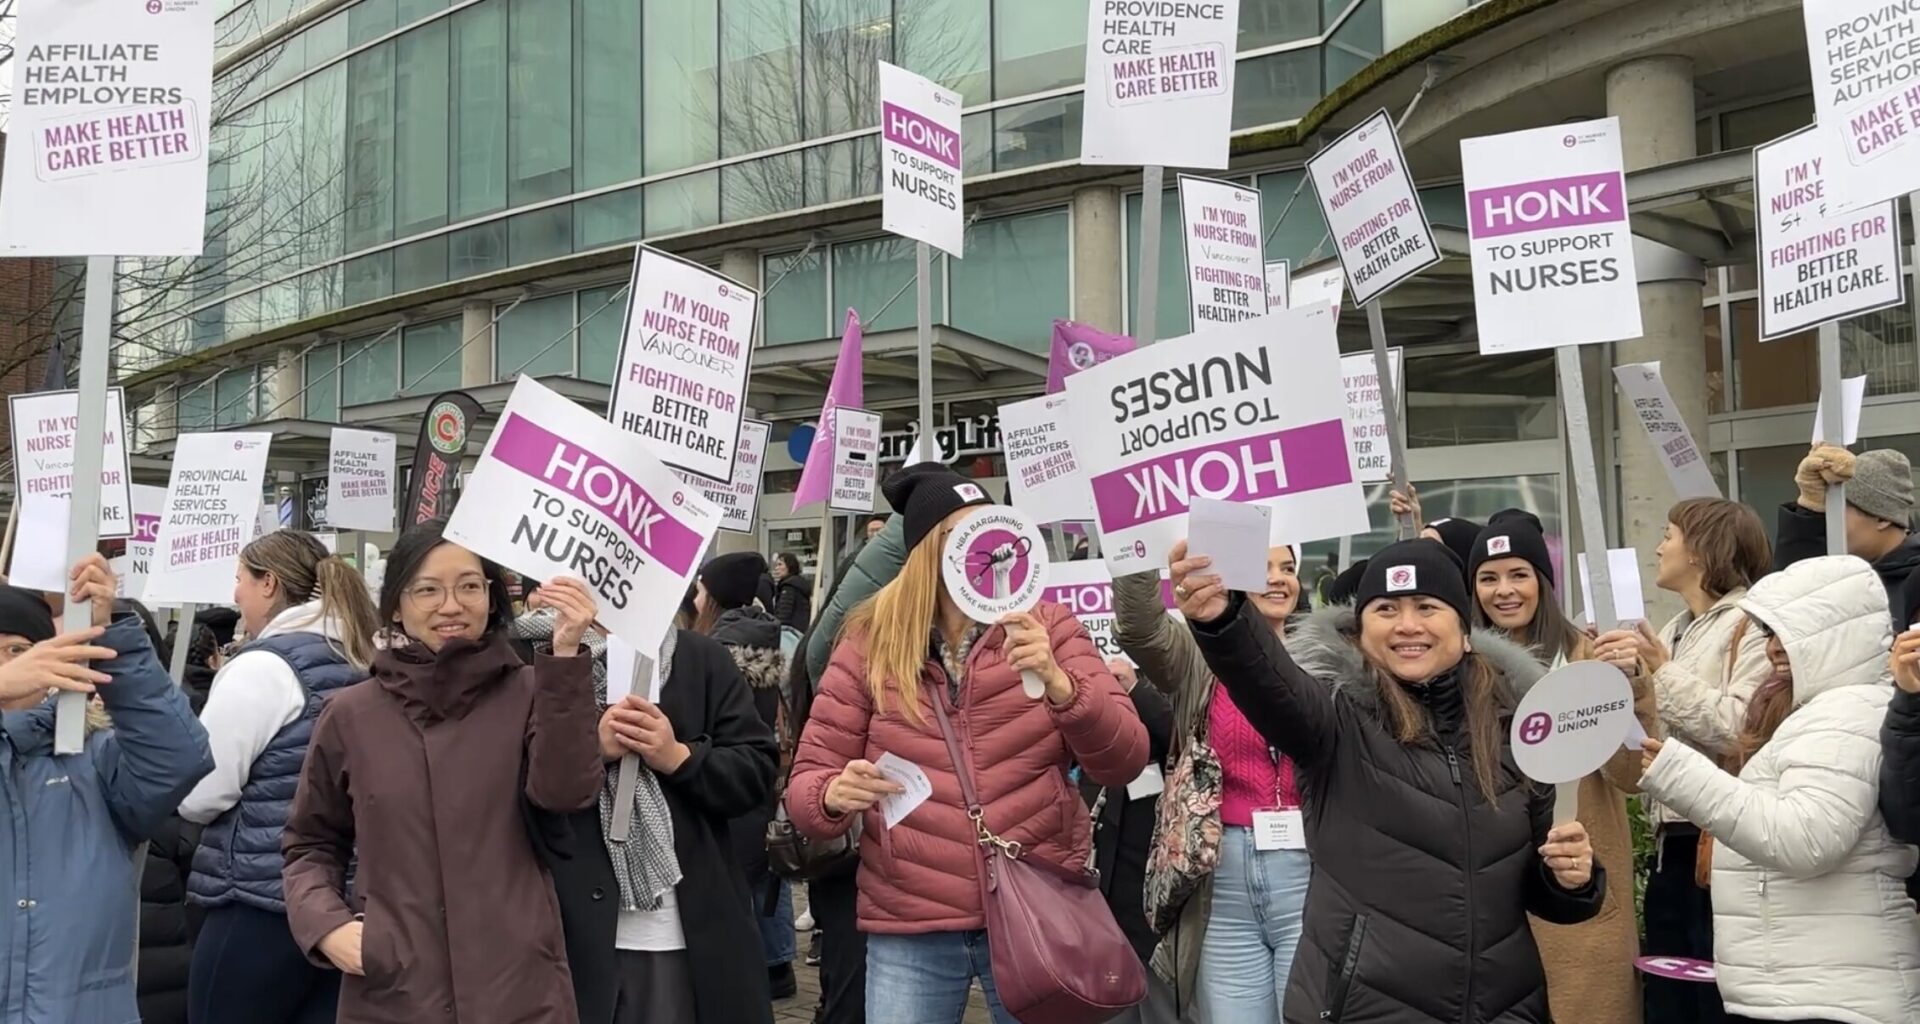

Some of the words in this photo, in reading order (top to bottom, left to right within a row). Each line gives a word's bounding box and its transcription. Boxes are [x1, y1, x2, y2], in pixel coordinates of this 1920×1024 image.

[1105, 1, 1224, 19] PROVIDENCE
[1103, 20, 1175, 36] HEALTH
[27, 44, 159, 62] AFFILIATE
[1102, 39, 1151, 54] CARE
[1828, 19, 1914, 65] HEALTH
[25, 65, 127, 84] HEALTH
[1114, 58, 1155, 80] MAKE
[1160, 51, 1215, 73] HEALTH
[24, 87, 182, 105] EMPLOYERS
[1116, 78, 1156, 99] CARE
[1161, 71, 1218, 93] BETTER
[45, 121, 101, 148] MAKE
[108, 109, 184, 138] HEALTH
[1851, 96, 1902, 137] MAKE
[891, 112, 954, 161] HONK
[1856, 116, 1907, 155] CARE
[48, 144, 103, 171] CARE
[109, 133, 188, 162] BETTER
[892, 149, 907, 165] TO
[910, 156, 955, 185] SUPPORT
[1332, 171, 1349, 188] I'M
[1349, 148, 1378, 173] YOUR
[1785, 164, 1808, 186] I'M
[892, 169, 955, 210] NURSES
[1329, 185, 1363, 211] NURSE
[1364, 160, 1395, 189] FROM
[1771, 180, 1824, 215] NURSE
[1202, 206, 1218, 221] I'M
[1220, 209, 1246, 228] YOUR
[1484, 183, 1610, 228] HONK
[1194, 224, 1228, 243] NURSE
[1231, 230, 1257, 248] FROM
[1342, 213, 1387, 251] FIGHTING
[1390, 198, 1412, 222] FOR
[1362, 226, 1400, 259] BETTER
[1487, 245, 1516, 261] TO
[1521, 233, 1614, 257] SUPPORT
[1771, 228, 1845, 269] FIGHTING
[1852, 215, 1886, 242] FOR
[1354, 254, 1390, 286] HEALTH
[1391, 234, 1425, 262] CARE.
[1797, 248, 1858, 283] BETTER
[1195, 266, 1242, 287] FIGHTING
[1244, 274, 1262, 291] FOR
[1490, 258, 1619, 295] NURSES
[1773, 279, 1832, 314] HEALTH
[1837, 264, 1889, 295] CARE.
[1214, 287, 1249, 307] BETTER
[663, 291, 685, 314] I'M
[691, 300, 730, 331] YOUR
[1198, 304, 1236, 322] HEALTH
[643, 310, 694, 342] NURSE
[699, 329, 740, 359] FROM
[629, 363, 702, 402] FIGHTING
[707, 387, 736, 413] FOR
[1111, 346, 1272, 423] NURSES
[38, 417, 58, 434] I'M
[62, 416, 78, 431] YO
[652, 395, 708, 429] BETTER
[1235, 398, 1279, 426] TO
[26, 435, 71, 452] NURSE
[622, 411, 682, 446] HEALTH
[686, 430, 727, 460] CARE.
[1007, 422, 1056, 440] AFFILIATE
[1008, 435, 1046, 450] HEALTH
[1121, 407, 1227, 456] SUPPORT
[334, 450, 377, 461] AFFILIATE
[334, 459, 367, 468] HEALTH
[1010, 440, 1069, 460] EMPLOYERS
[179, 470, 248, 482] PROVINCIAL
[333, 467, 385, 478] EMPLOYERS
[1021, 464, 1043, 478] MAKE
[1044, 451, 1072, 470] HEALTH
[1024, 472, 1045, 488] CARE
[1047, 461, 1076, 480] BETTER
[27, 473, 73, 493] FIGHTI
[101, 471, 121, 485] OR
[175, 485, 220, 496] HEALTH
[341, 480, 359, 490] MAKE
[361, 479, 386, 487] HEALTH
[342, 488, 360, 498] CARE
[362, 487, 387, 497] BETTER
[735, 484, 754, 495] FOR
[844, 478, 865, 489] BETTER
[1124, 439, 1288, 519] HONK
[172, 499, 227, 511] SERVICES
[544, 443, 666, 549] HONK
[835, 490, 855, 499] HEALTH
[103, 506, 124, 521] RE.
[169, 514, 239, 525] AUTHORITY
[171, 534, 198, 551] MAKE
[201, 527, 240, 545] HEALTH
[533, 489, 565, 517] TO
[568, 508, 645, 575] SUPPORT
[955, 531, 971, 550] NBA
[970, 515, 1023, 531] BARGAINING
[170, 549, 197, 566] CARE
[199, 542, 239, 560] BETTER
[511, 515, 633, 609] NURSES
[959, 586, 977, 607] MAKE
[977, 602, 1007, 614] HEALTH
[1009, 592, 1028, 610] CARE
[1027, 563, 1040, 594] BETTER
[1557, 718, 1598, 733] UNION
[1558, 710, 1575, 722] BC
